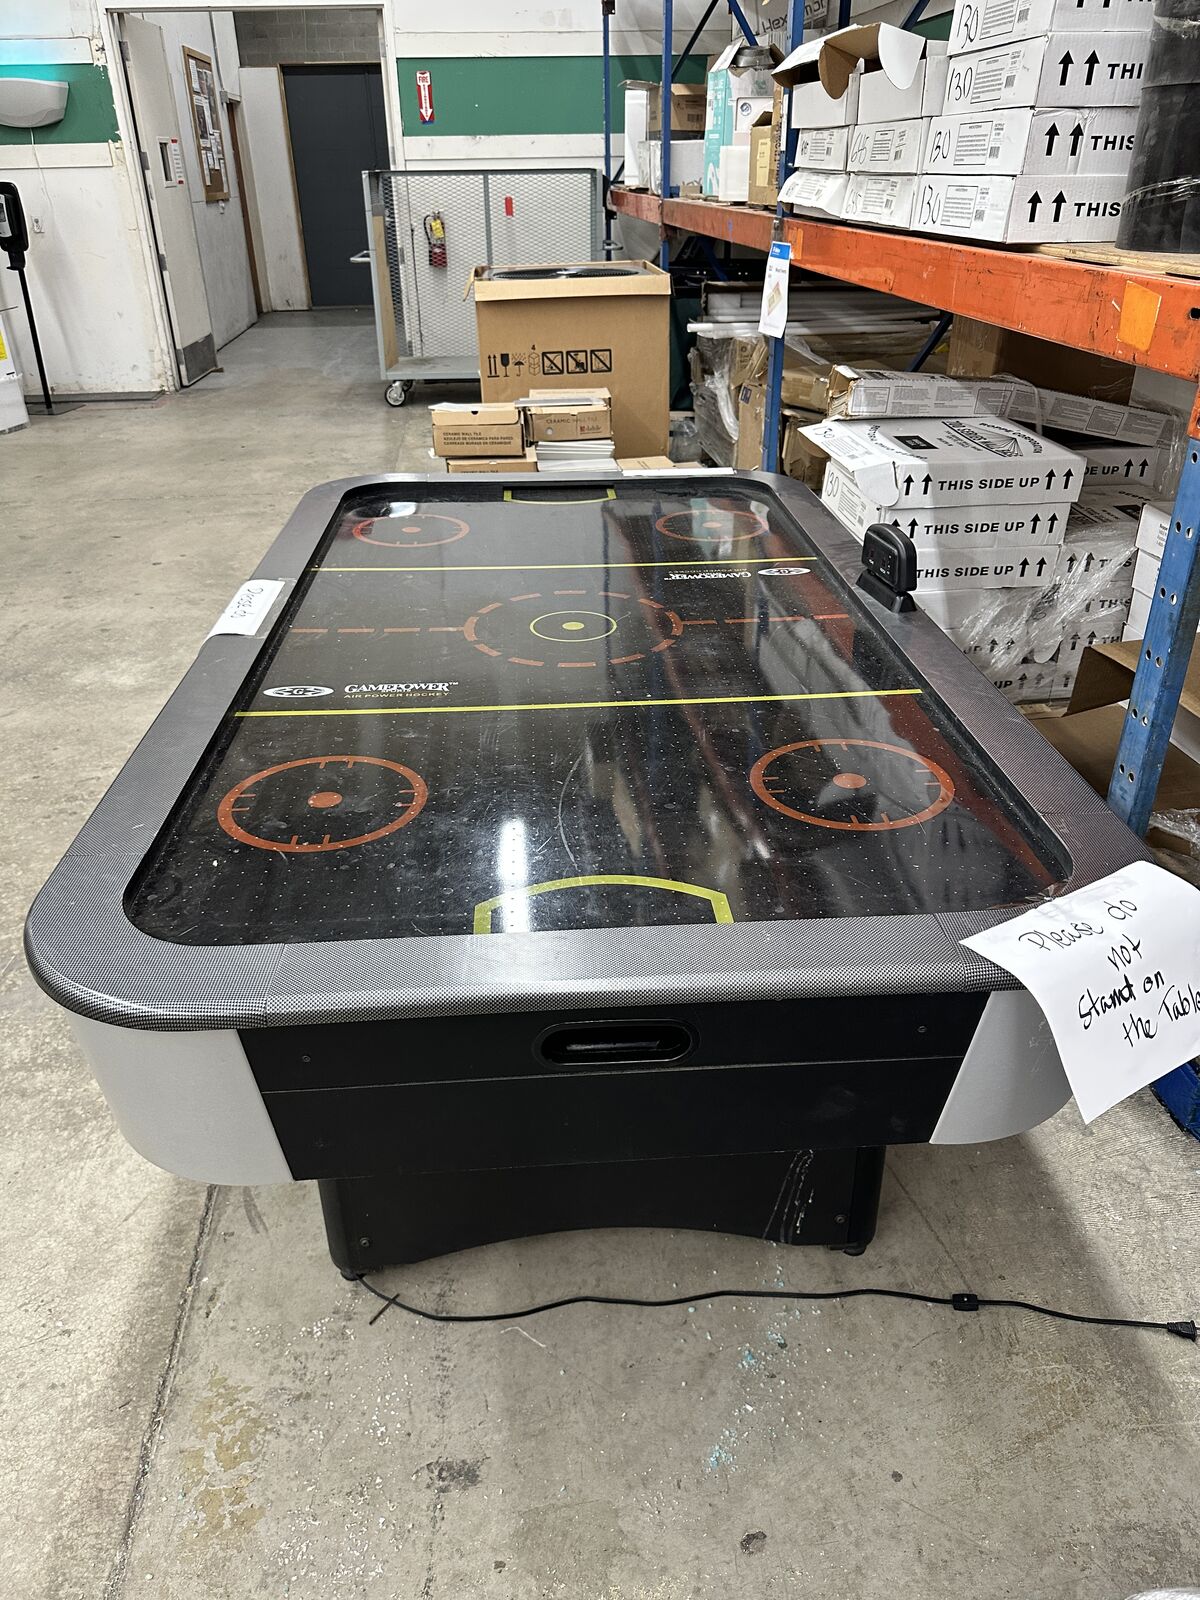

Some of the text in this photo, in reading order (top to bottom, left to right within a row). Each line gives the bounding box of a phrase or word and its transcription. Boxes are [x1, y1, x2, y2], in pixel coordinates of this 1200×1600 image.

[957, 4, 979, 49] 130
[947, 66, 973, 101] 130
[1107, 63, 1144, 79] THI
[929, 129, 951, 163] 130
[918, 184, 941, 225] 130
[1073, 202, 1121, 217] THIS
[825, 469, 840, 498] 130
[938, 477, 1040, 491] THIS SIDE UP
[1102, 465, 1120, 475] UP
[924, 521, 1025, 535] THIS SIDE UP
[916, 565, 1014, 579] THIS SIDE UP
[1018, 899, 1138, 951] Please do
[1078, 970, 1165, 1030] Stand on
[1122, 1012, 1159, 1048] the
